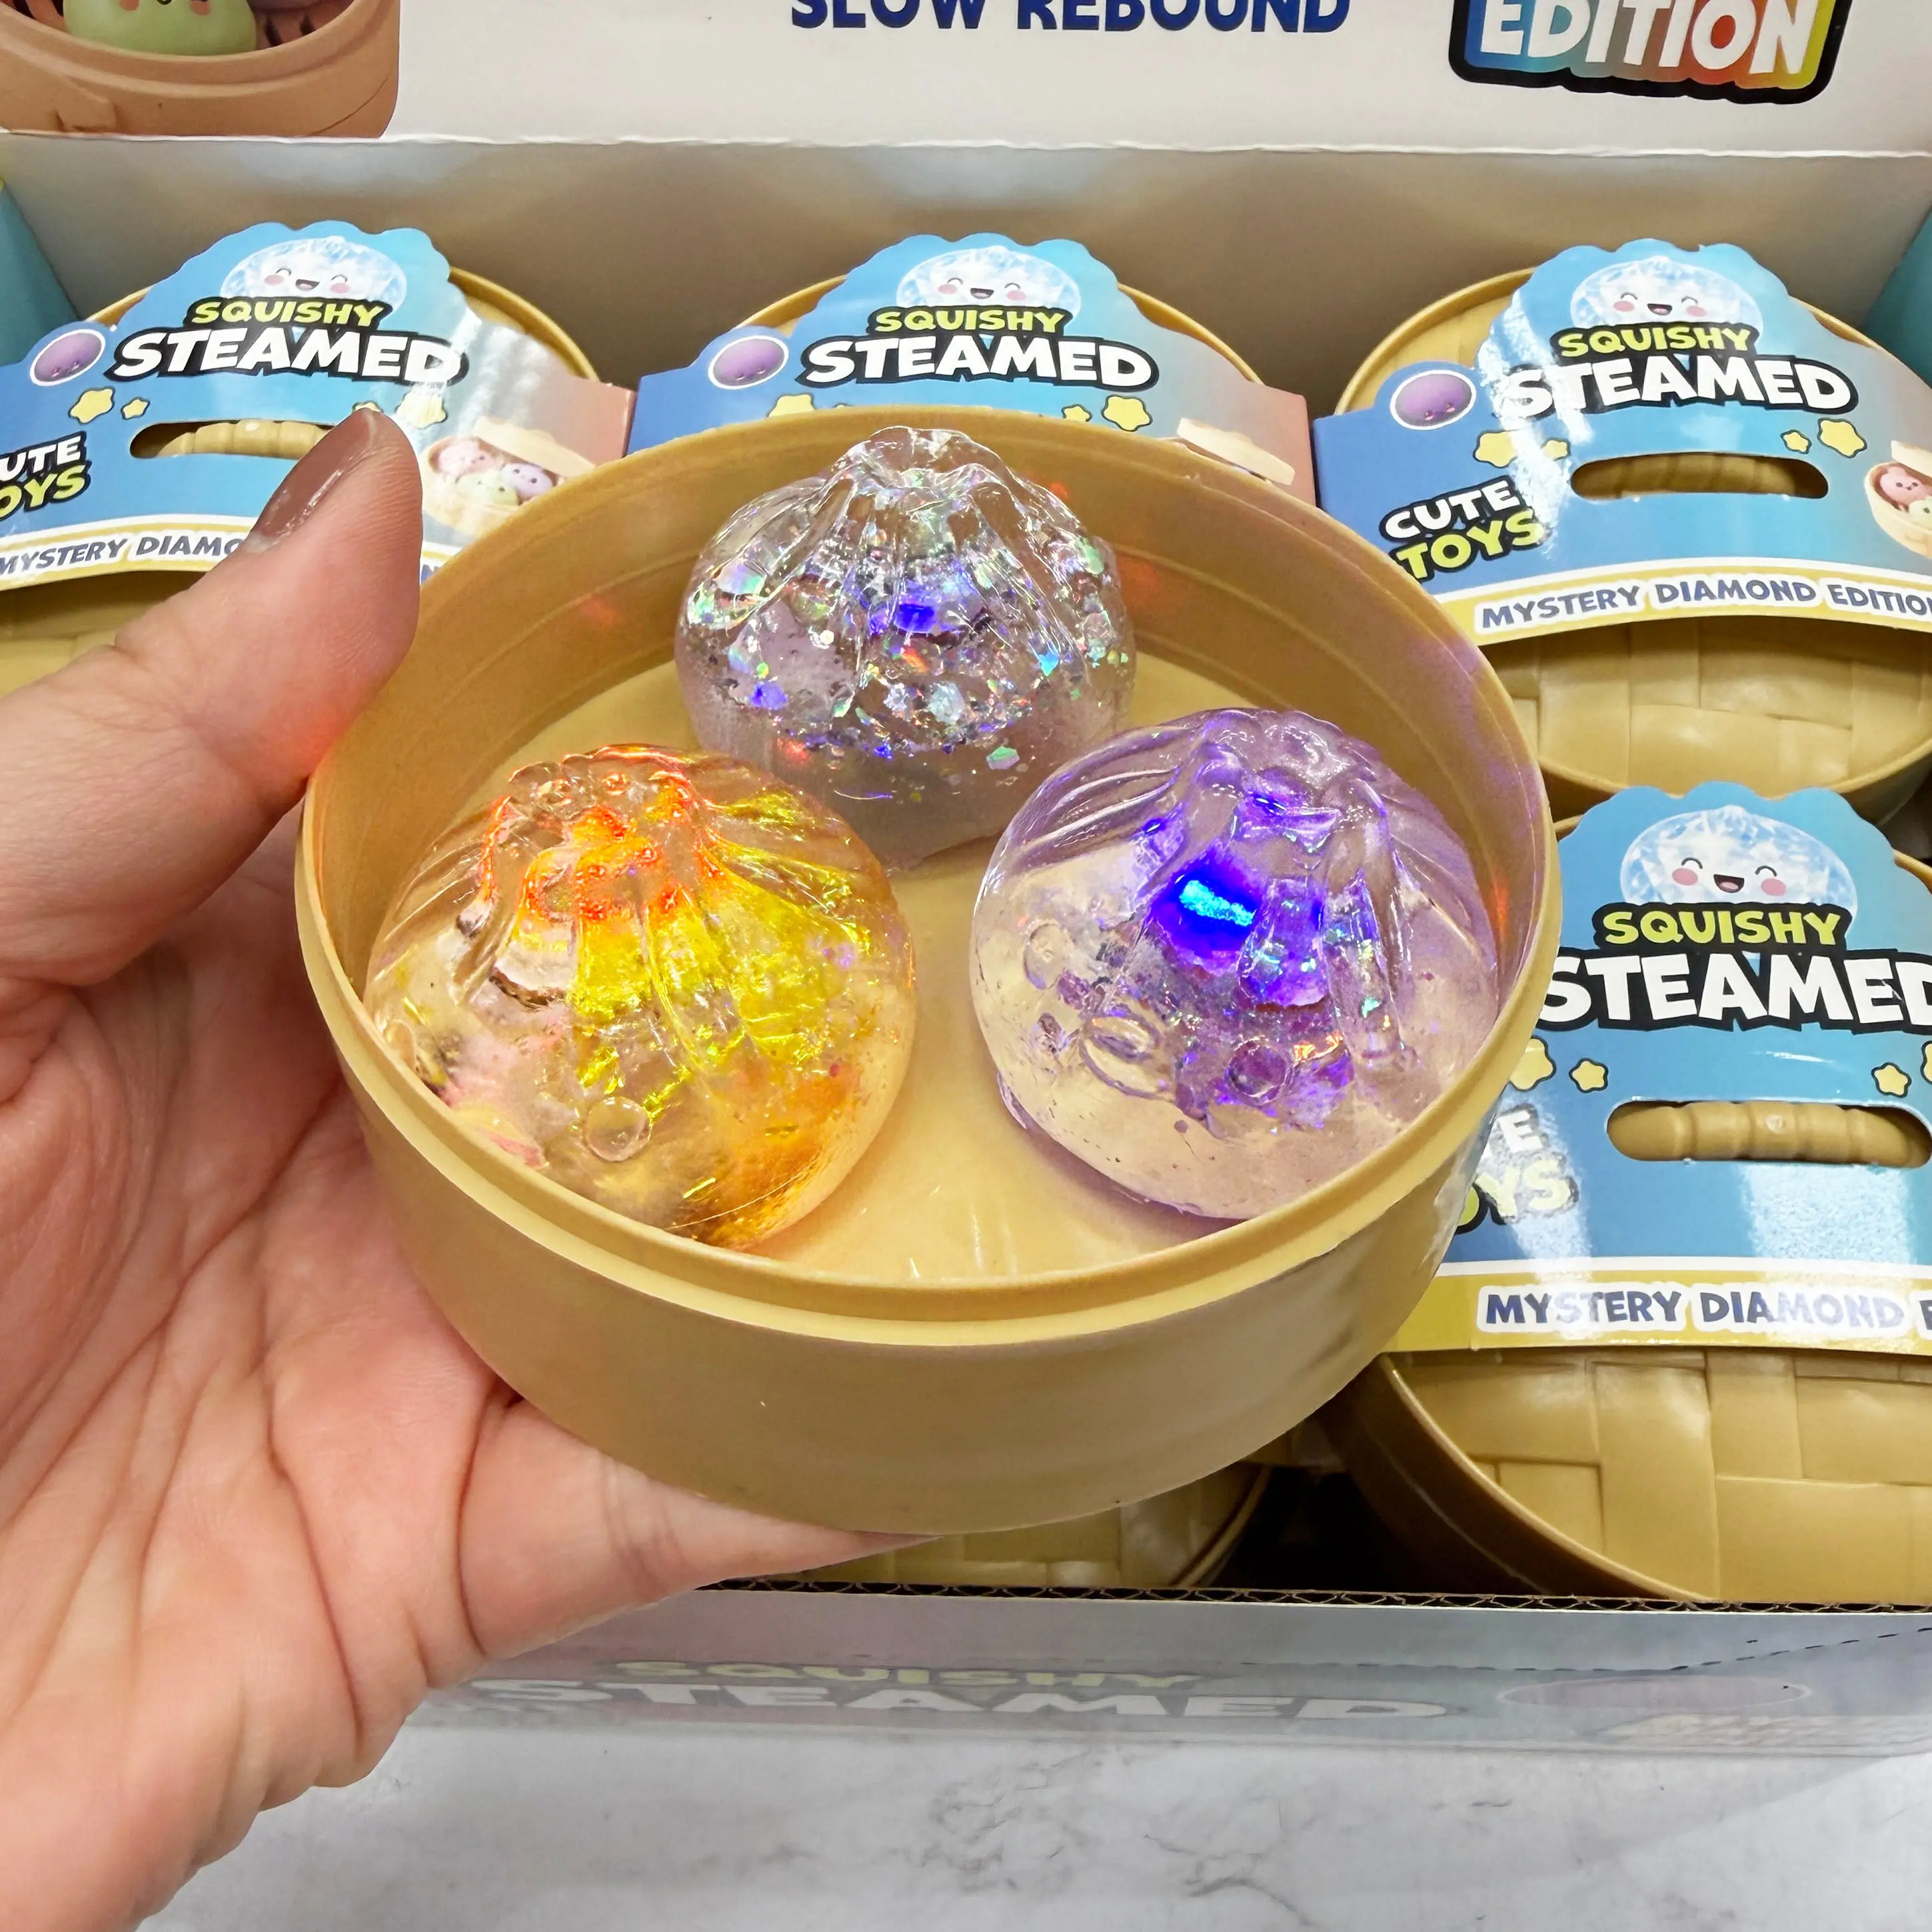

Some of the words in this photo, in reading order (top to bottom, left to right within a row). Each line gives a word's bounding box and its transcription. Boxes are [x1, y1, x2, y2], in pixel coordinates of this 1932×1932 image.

[191, 301, 384, 327] SQUISHY
[875, 309, 1066, 333] SQUISHY
[113, 327, 461, 383] STEAMED
[805, 335, 1152, 387] STEAMED
[1557, 327, 1751, 357] SQUISHY
[1502, 354, 1851, 418] STEAMED
[0, 435, 81, 481] UTE
[0, 465, 86, 518] OYS
[1385, 480, 1521, 539] CUTE
[1396, 508, 1545, 580] TOYS
[1481, 584, 1640, 628] MYSTERY
[1655, 578, 1817, 604] DIAMOND
[1827, 584, 1932, 616] EDITIO
[1603, 910, 1841, 945] SQUISHY
[1485, 1290, 1682, 1324] MYSTERY
[1700, 1290, 1905, 1328] DIAMOND
[470, 1679, 1447, 1719] STEAMED
